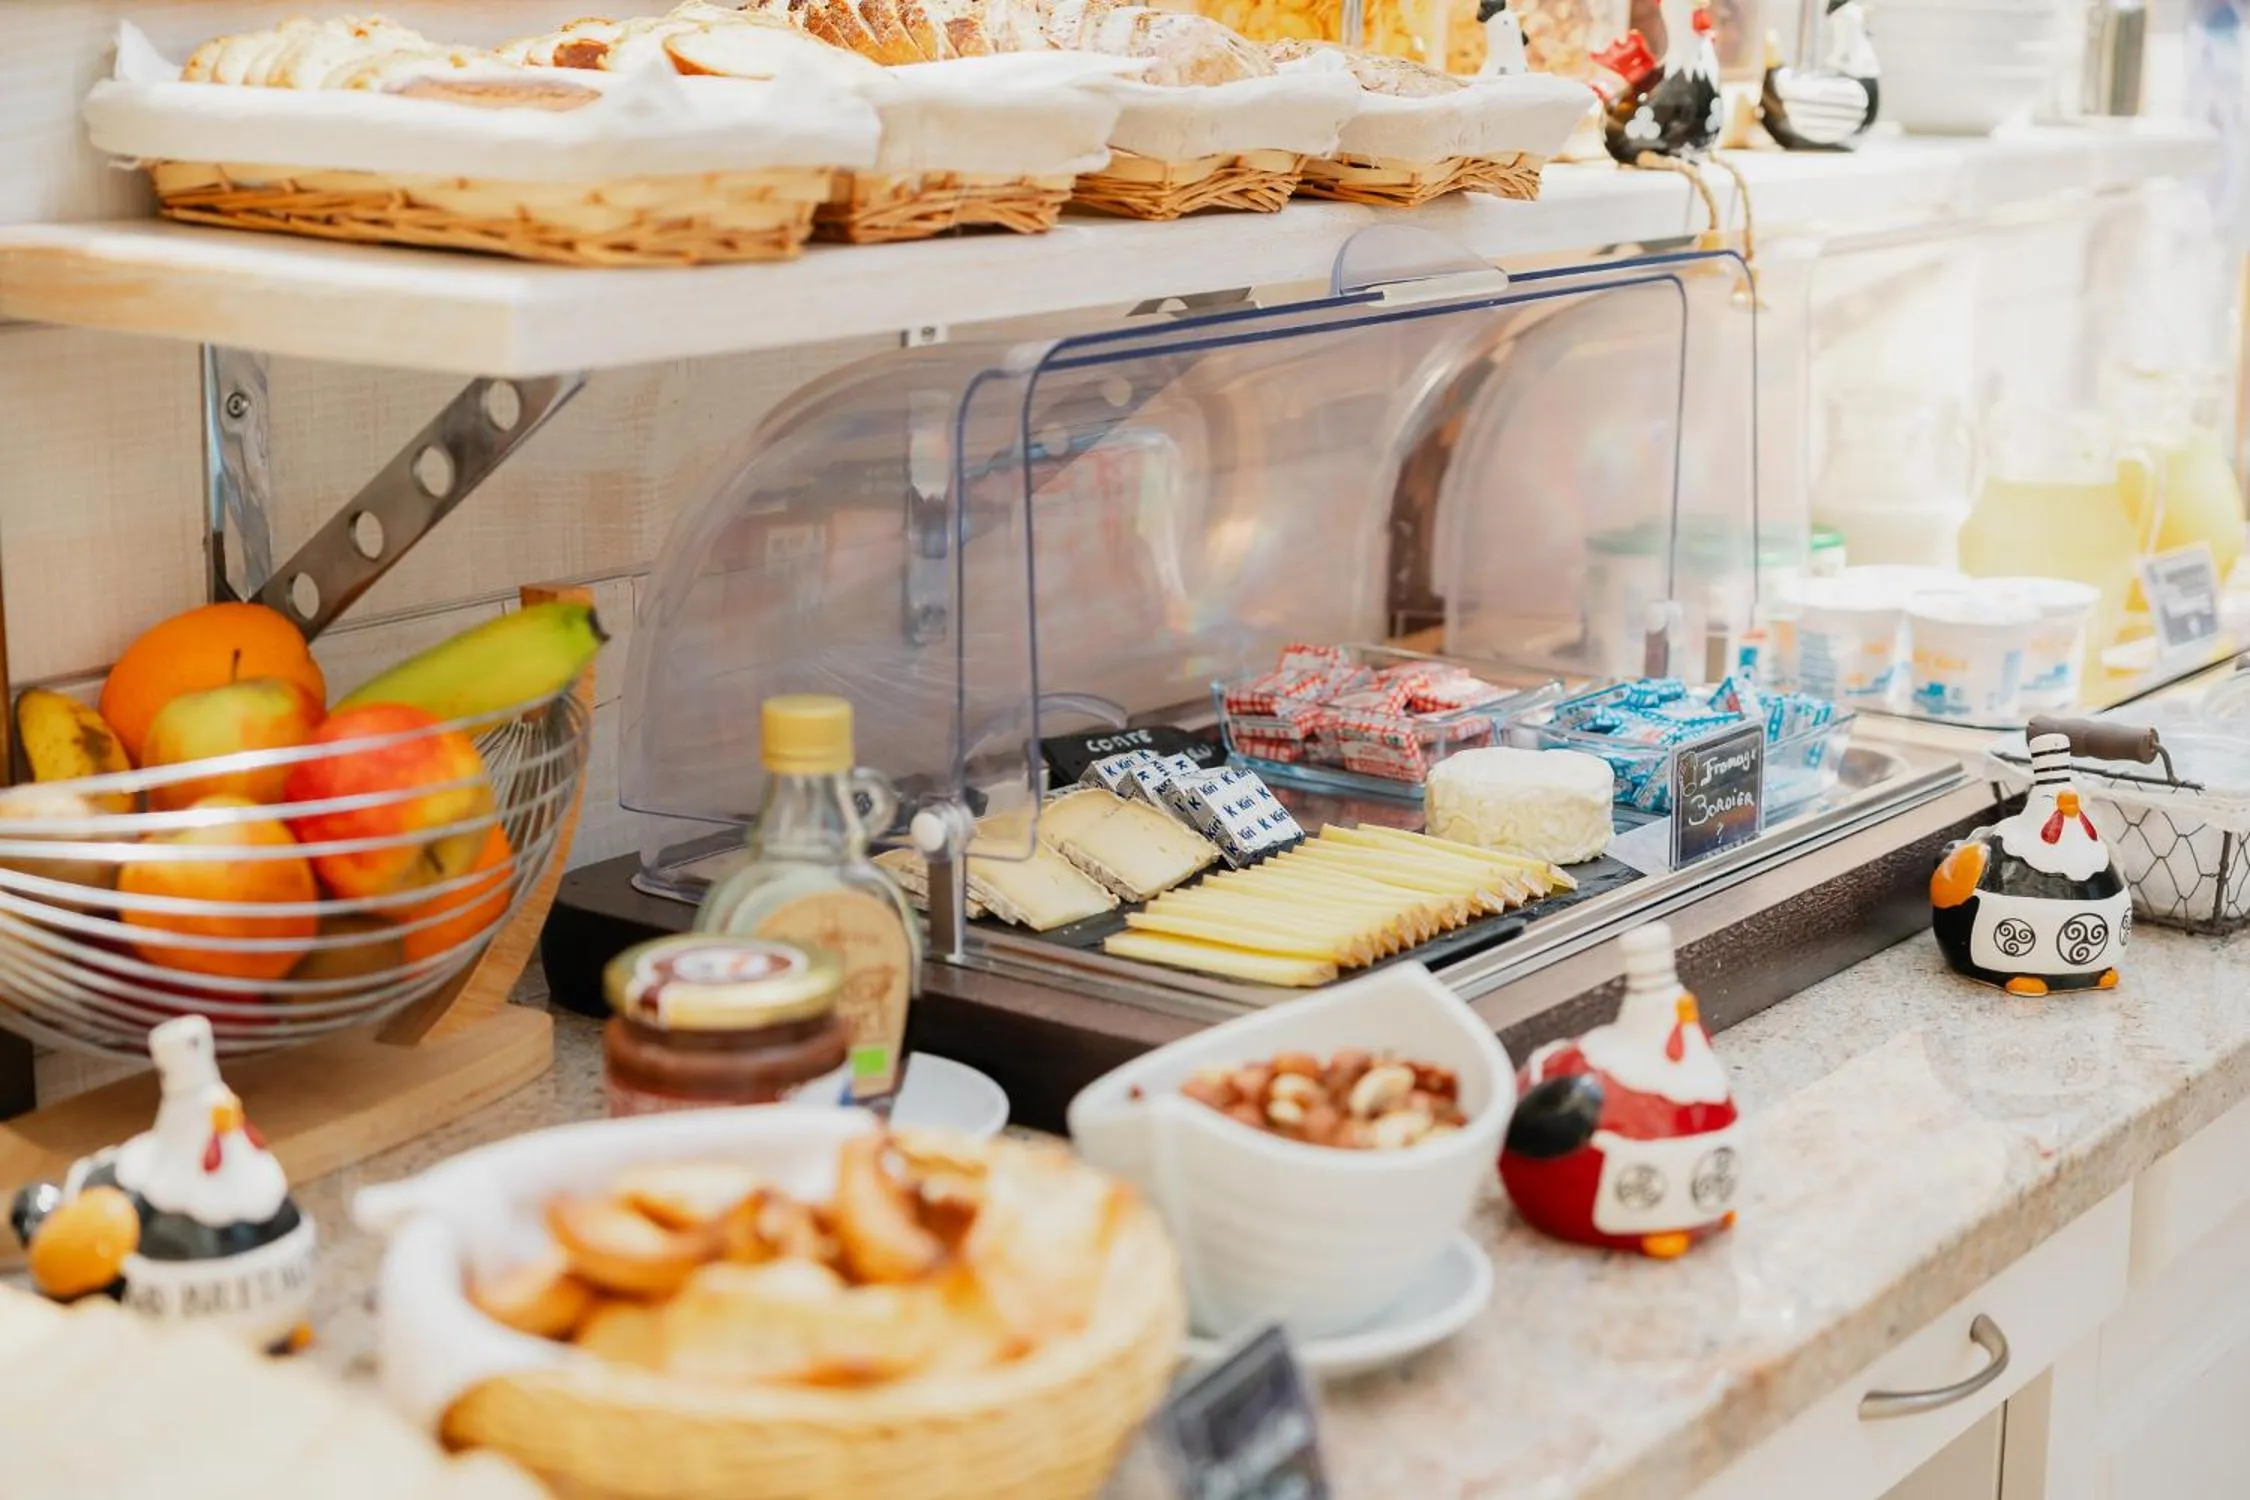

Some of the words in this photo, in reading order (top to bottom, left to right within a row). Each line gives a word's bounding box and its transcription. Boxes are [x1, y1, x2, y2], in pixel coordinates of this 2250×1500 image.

[1115, 756, 1136, 771] Kiri
[1200, 781, 1219, 796] Kiri
[1235, 795, 1256, 811] Kiri
[1205, 814, 1223, 840] Kiri
[1237, 825, 1257, 840] Kiri
[1269, 807, 1290, 824] Kiri
